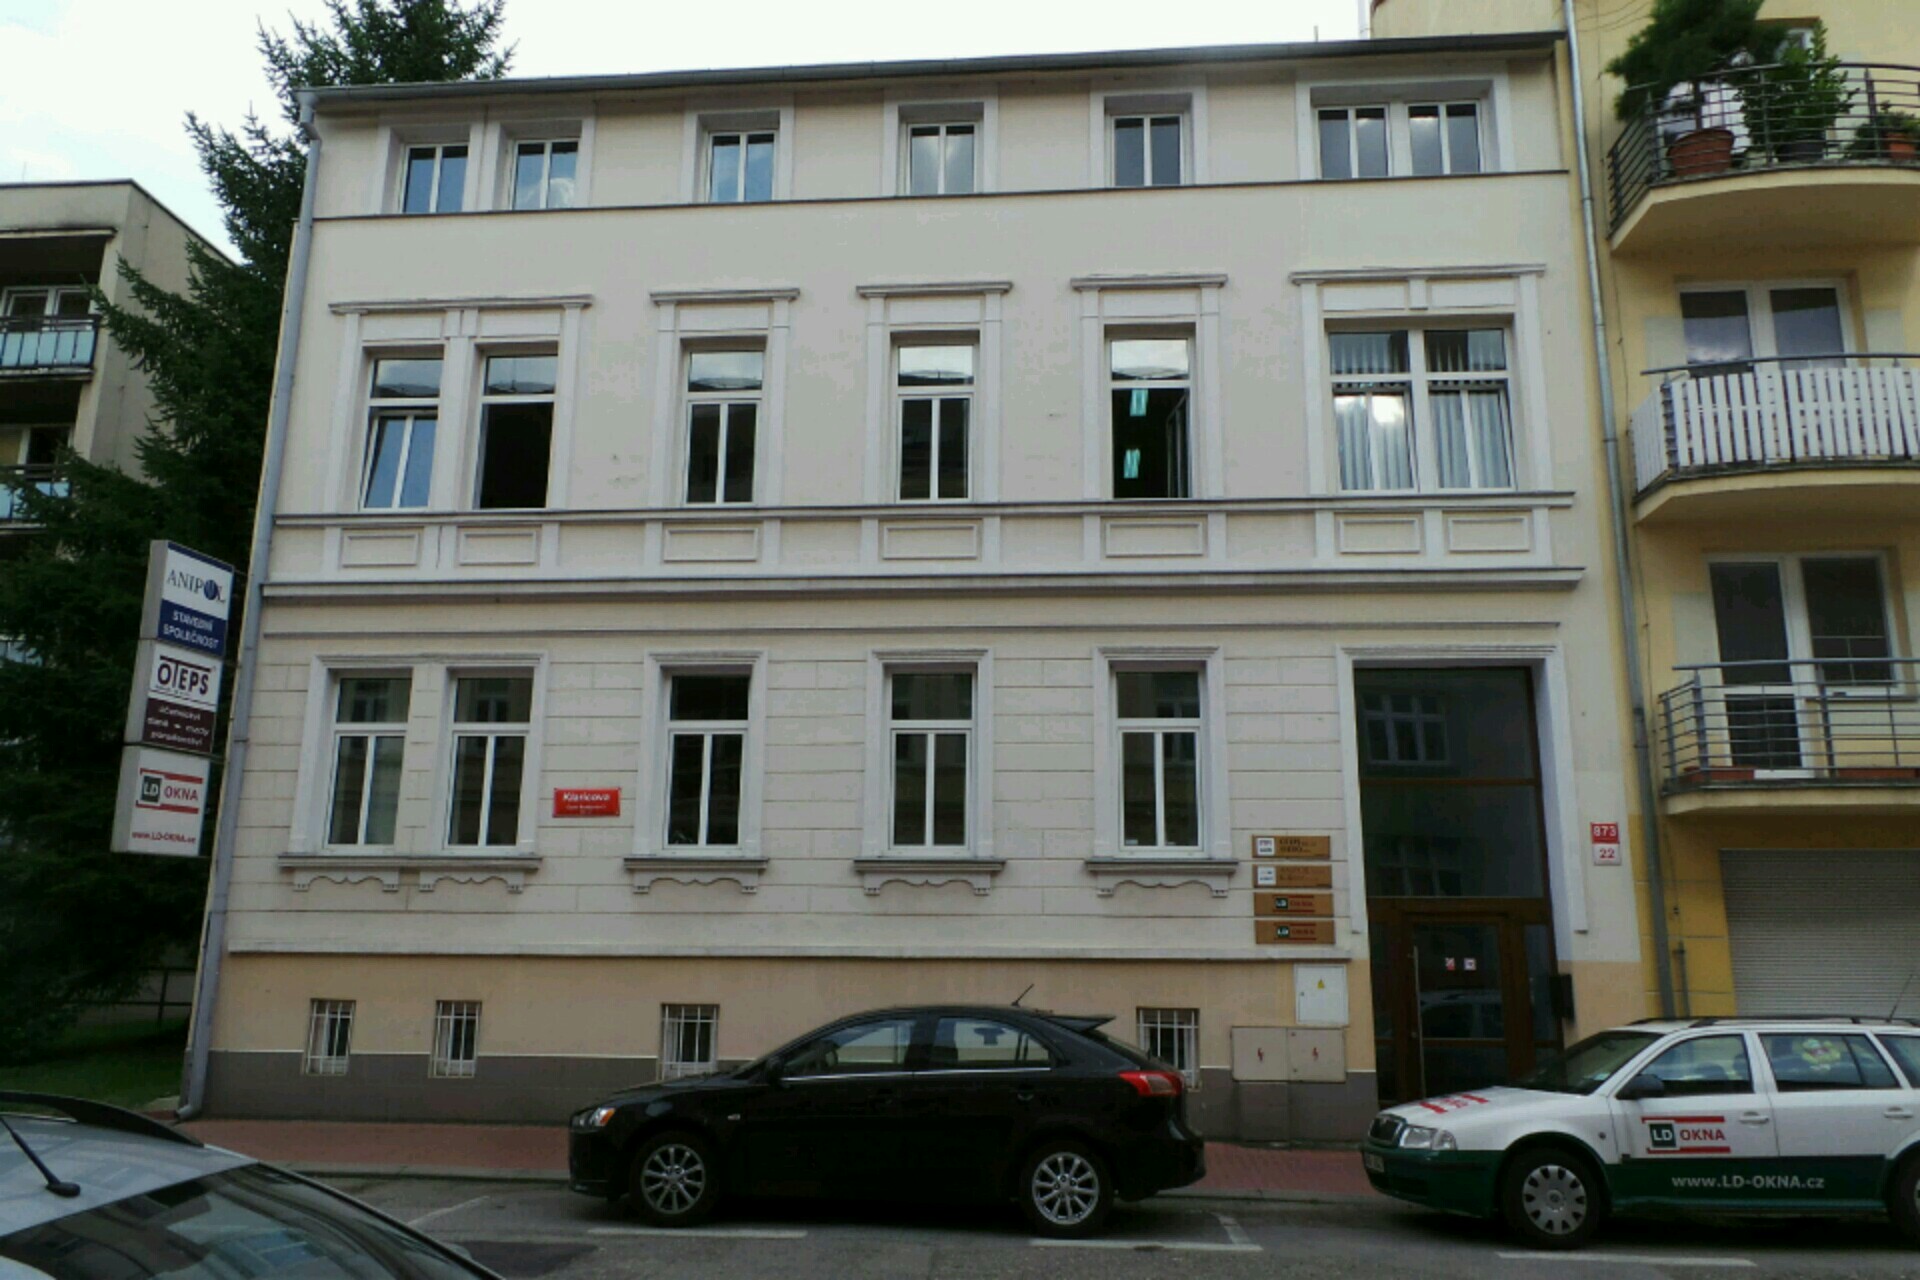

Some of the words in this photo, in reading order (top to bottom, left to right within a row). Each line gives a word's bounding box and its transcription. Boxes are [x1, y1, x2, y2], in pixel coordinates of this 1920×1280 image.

[167, 569, 226, 604] ANIPOL
[157, 656, 211, 695] OTEPS
[143, 781, 159, 797] LD
[164, 785, 199, 801] OKNA
[1652, 1129, 1673, 1142] LD
[1679, 1129, 1726, 1141] OKNA
[1671, 1175, 1825, 1189] www.LD-OKNA.cz
